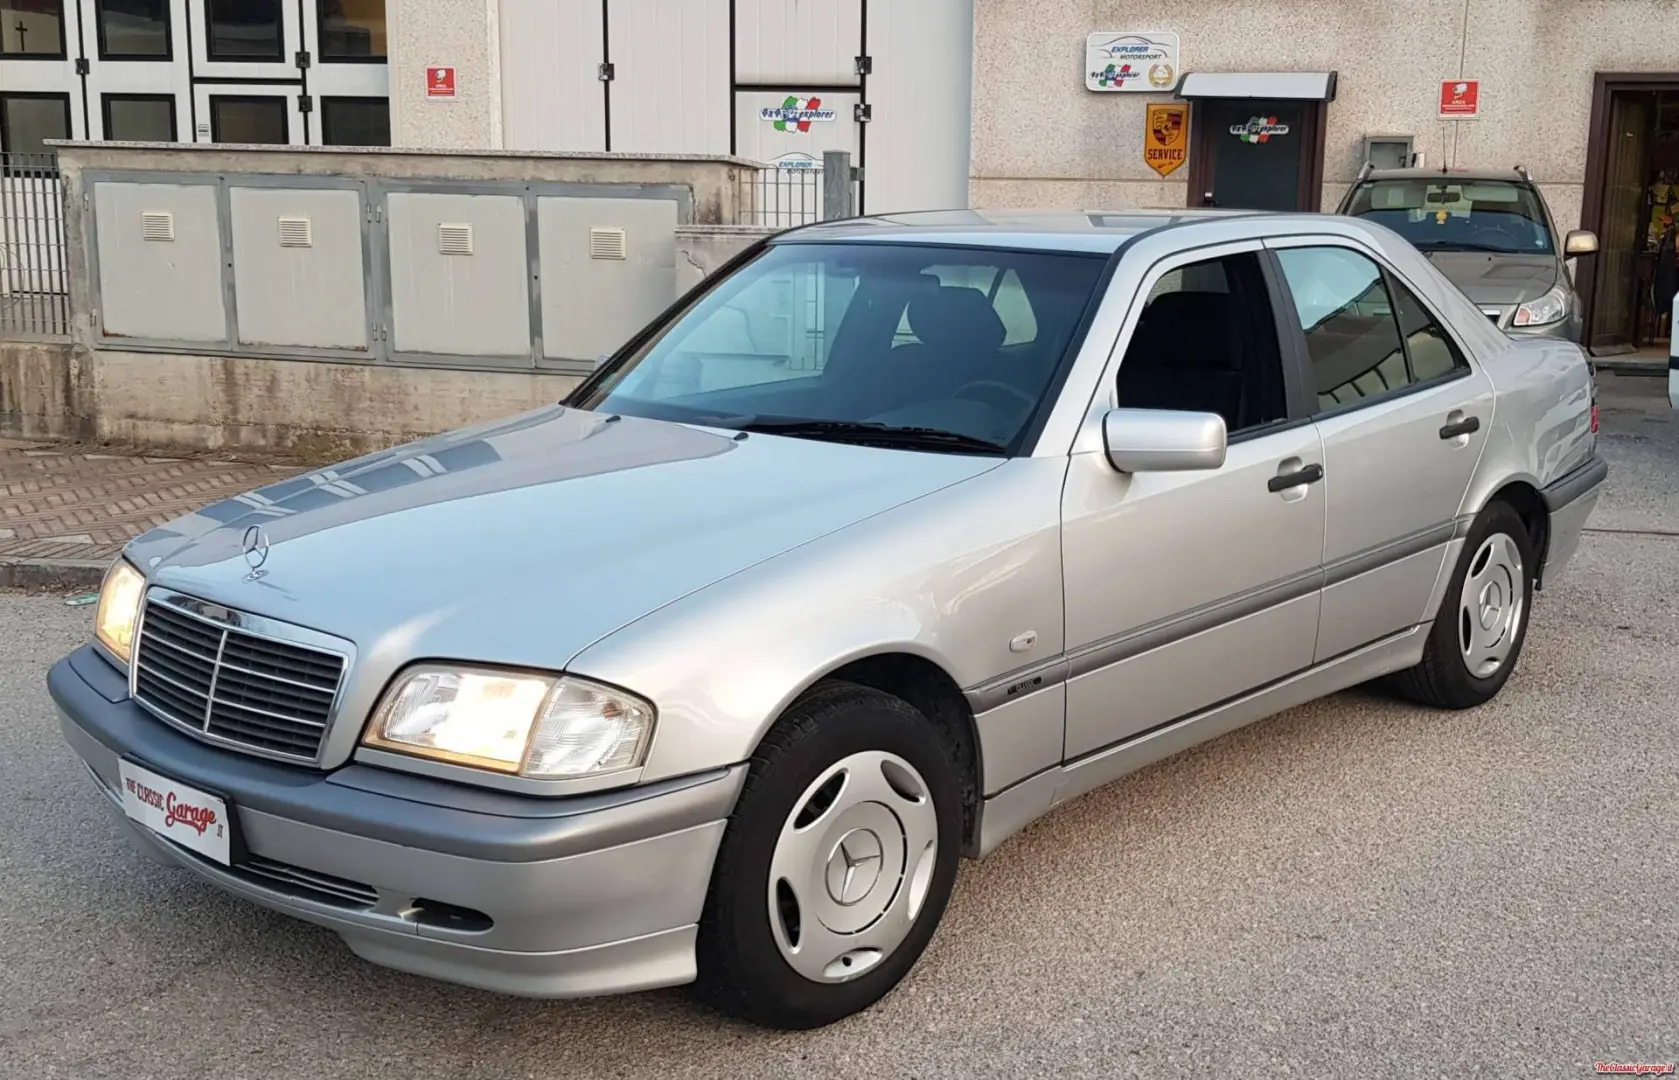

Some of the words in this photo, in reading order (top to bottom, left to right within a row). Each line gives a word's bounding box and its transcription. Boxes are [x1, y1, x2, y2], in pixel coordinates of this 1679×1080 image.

[799, 110, 834, 120] explorer
[1148, 148, 1183, 160] SERVICE
[126, 778, 136, 794] THE
[137, 783, 165, 811] CLASSIC
[165, 791, 217, 837] Garage
